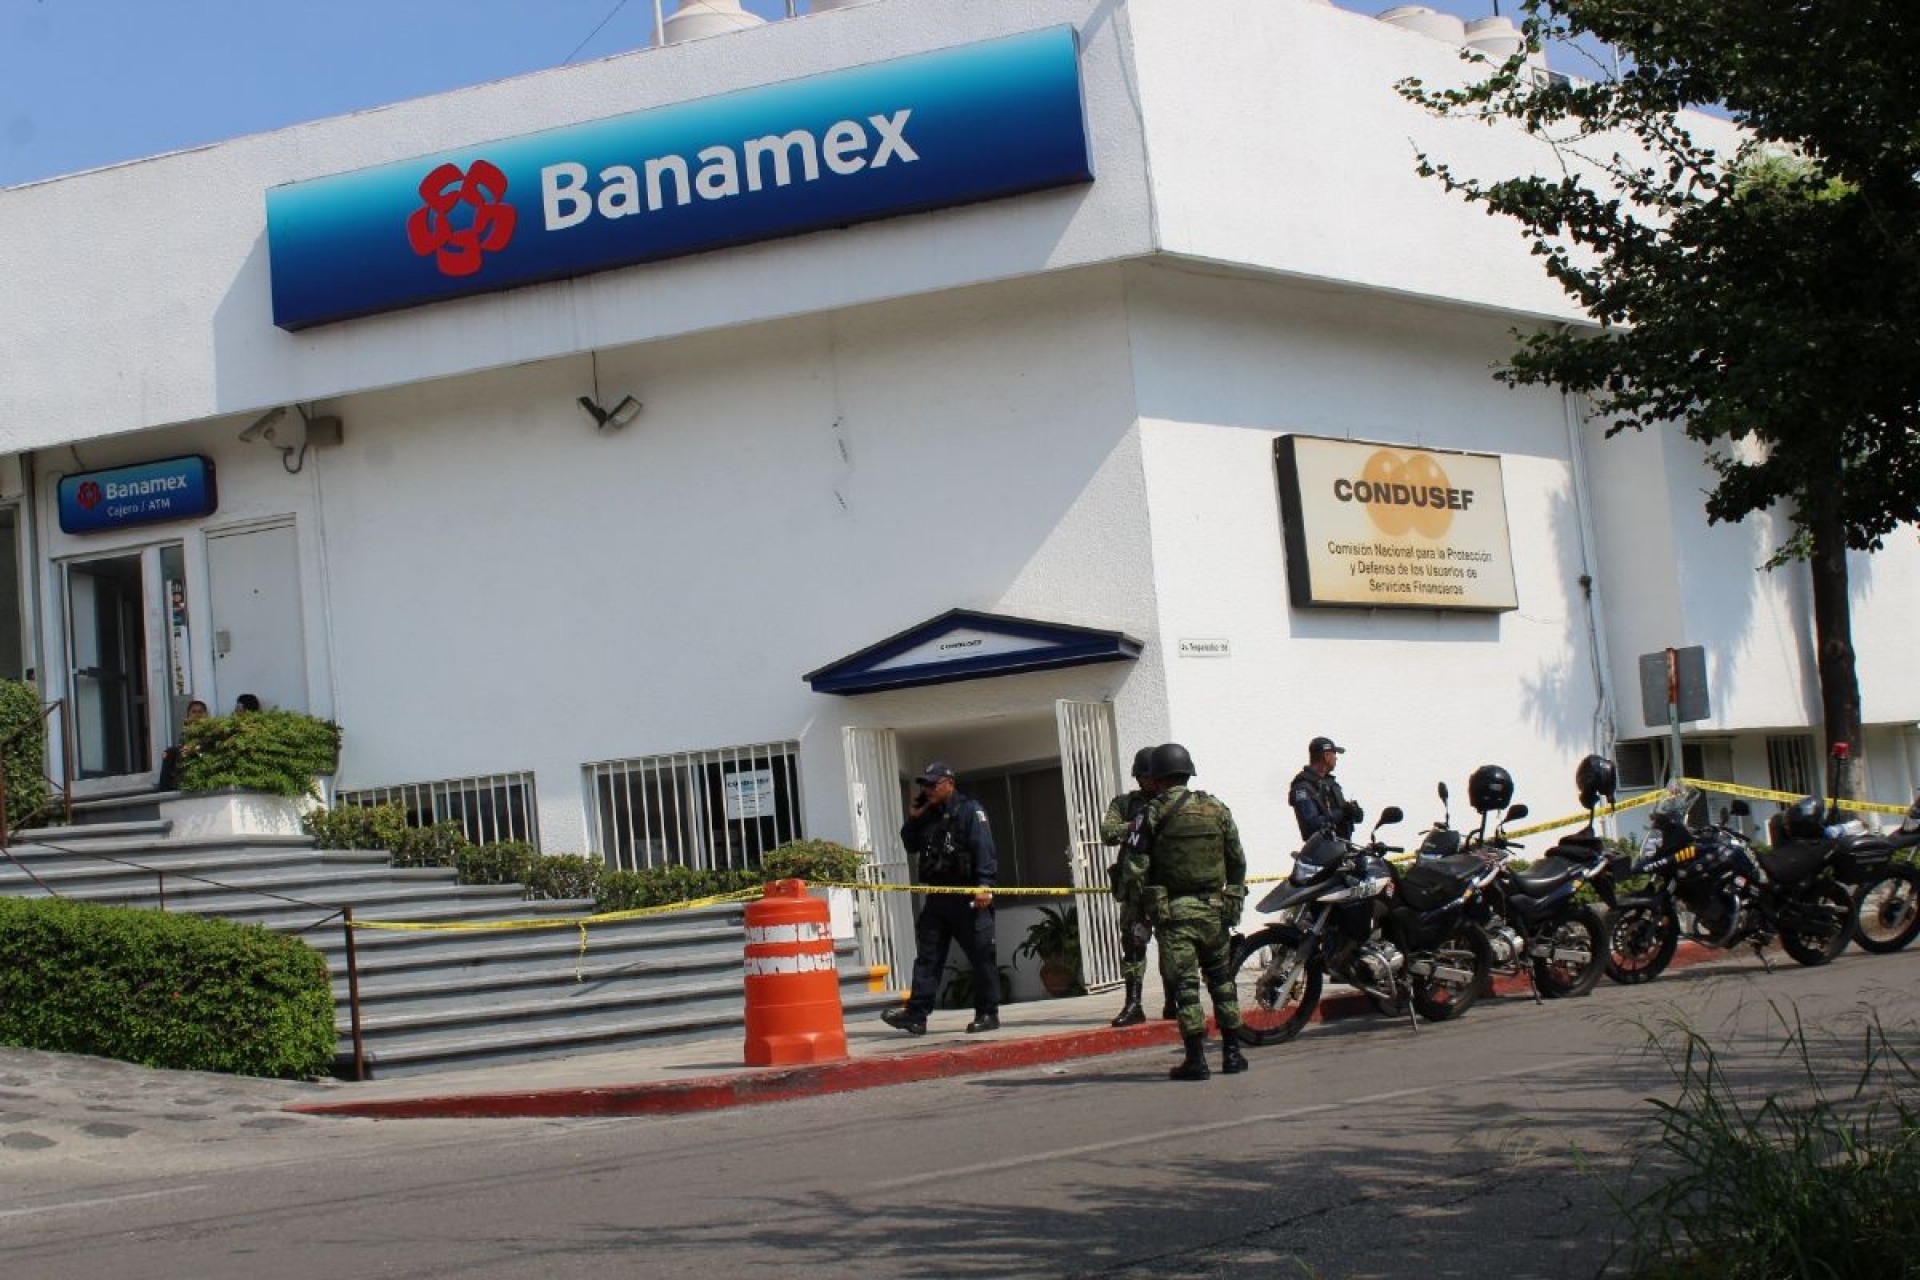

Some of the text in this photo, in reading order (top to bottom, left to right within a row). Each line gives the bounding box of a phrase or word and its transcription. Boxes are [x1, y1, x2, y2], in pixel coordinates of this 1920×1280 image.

[540, 108, 920, 231] Banamex
[105, 474, 187, 500] Banamex
[1333, 479, 1474, 511] CONDUSEF
[106, 504, 139, 518] Cajero
[148, 498, 171, 511] ATM
[1327, 540, 1492, 562] Comisión Nacional para la Protección
[1350, 561, 1478, 578] y Defensa de los Usuarios de
[1369, 578, 1464, 595] Servicios Financieros
